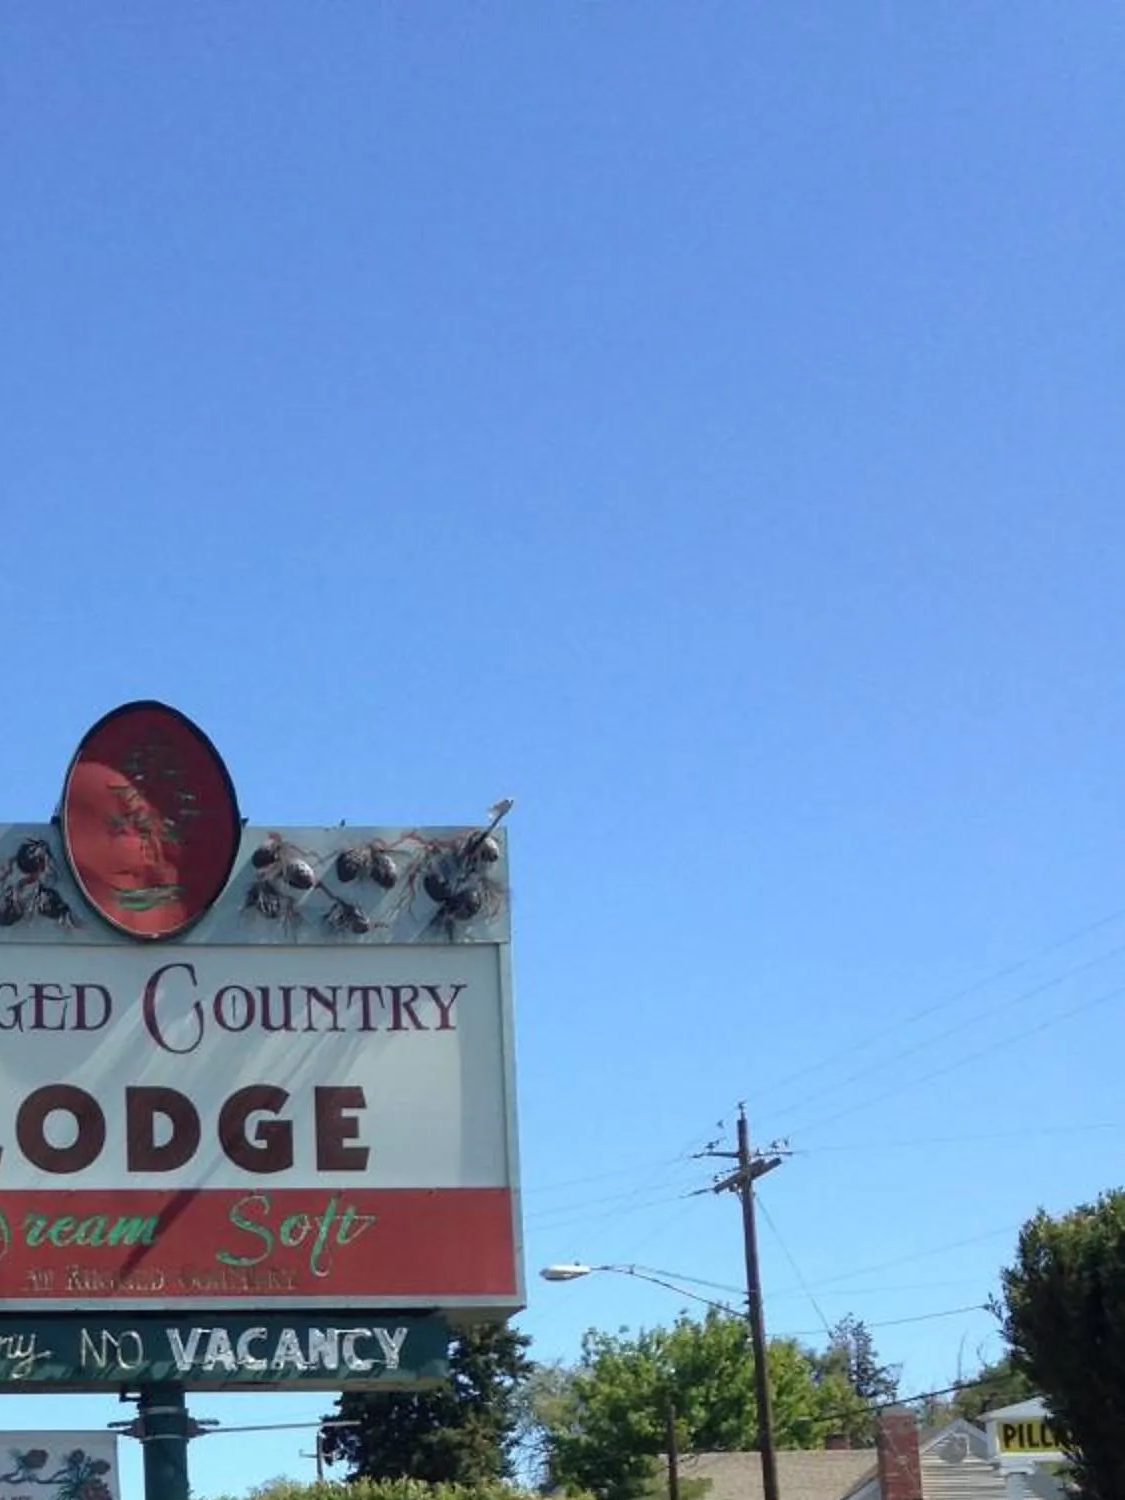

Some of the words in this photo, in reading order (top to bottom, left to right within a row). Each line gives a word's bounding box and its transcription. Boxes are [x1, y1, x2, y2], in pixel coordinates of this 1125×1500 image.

[142, 962, 468, 1055] COUNTRY
[216, 1193, 377, 1279] Soft
[166, 1326, 410, 1372] VACANCY
[1002, 1423, 1063, 1449] PILL
